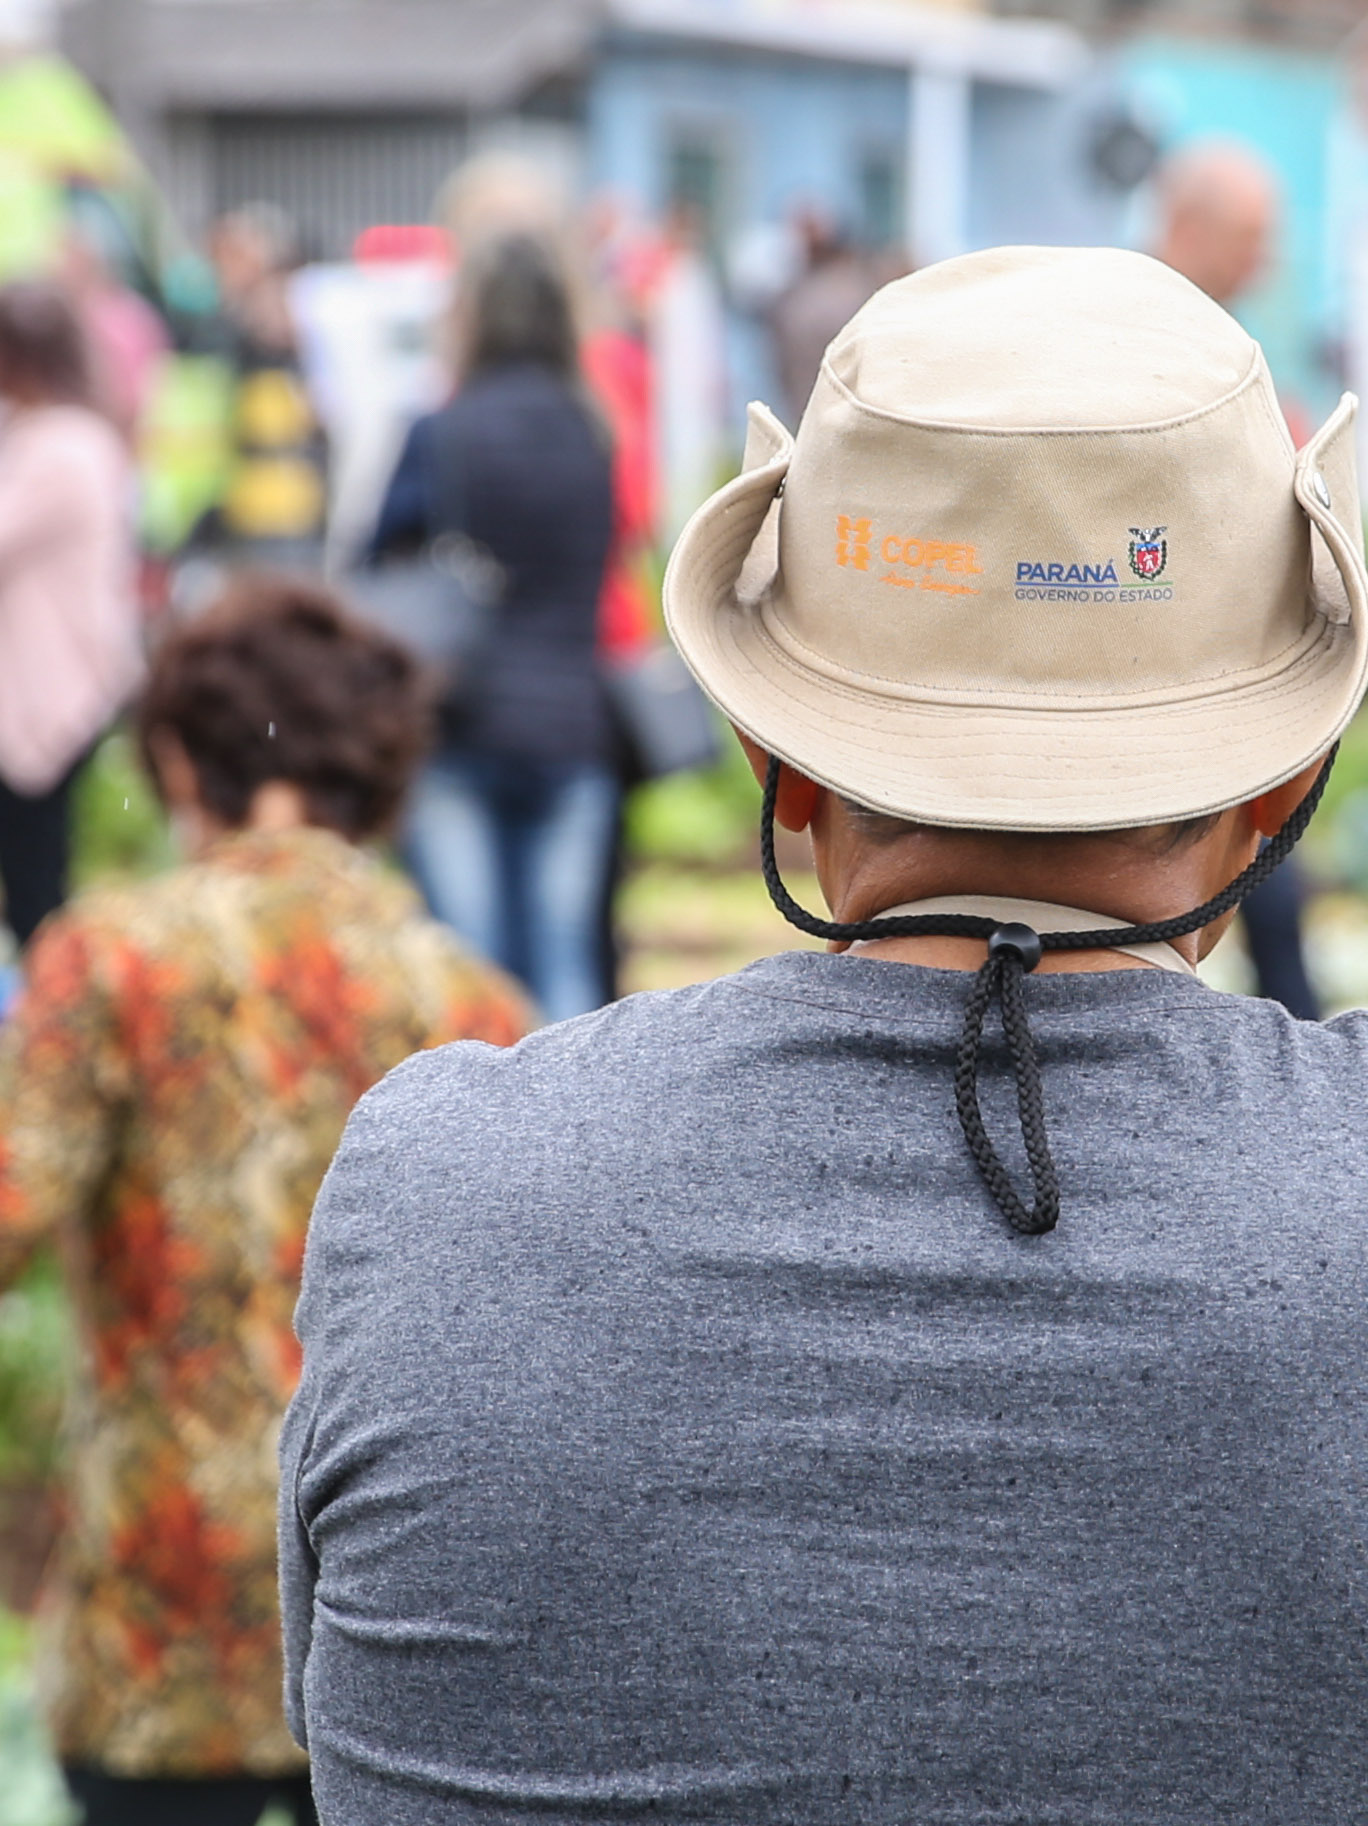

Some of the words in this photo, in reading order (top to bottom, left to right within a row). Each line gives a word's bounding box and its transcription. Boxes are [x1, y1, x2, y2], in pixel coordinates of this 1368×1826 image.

[881, 534, 984, 575] COPEL
[1016, 557, 1118, 583] PARANÁ
[1014, 588, 1090, 602] GOVERNO
[1093, 590, 1116, 603] DO
[1119, 587, 1174, 603] ESTADO
